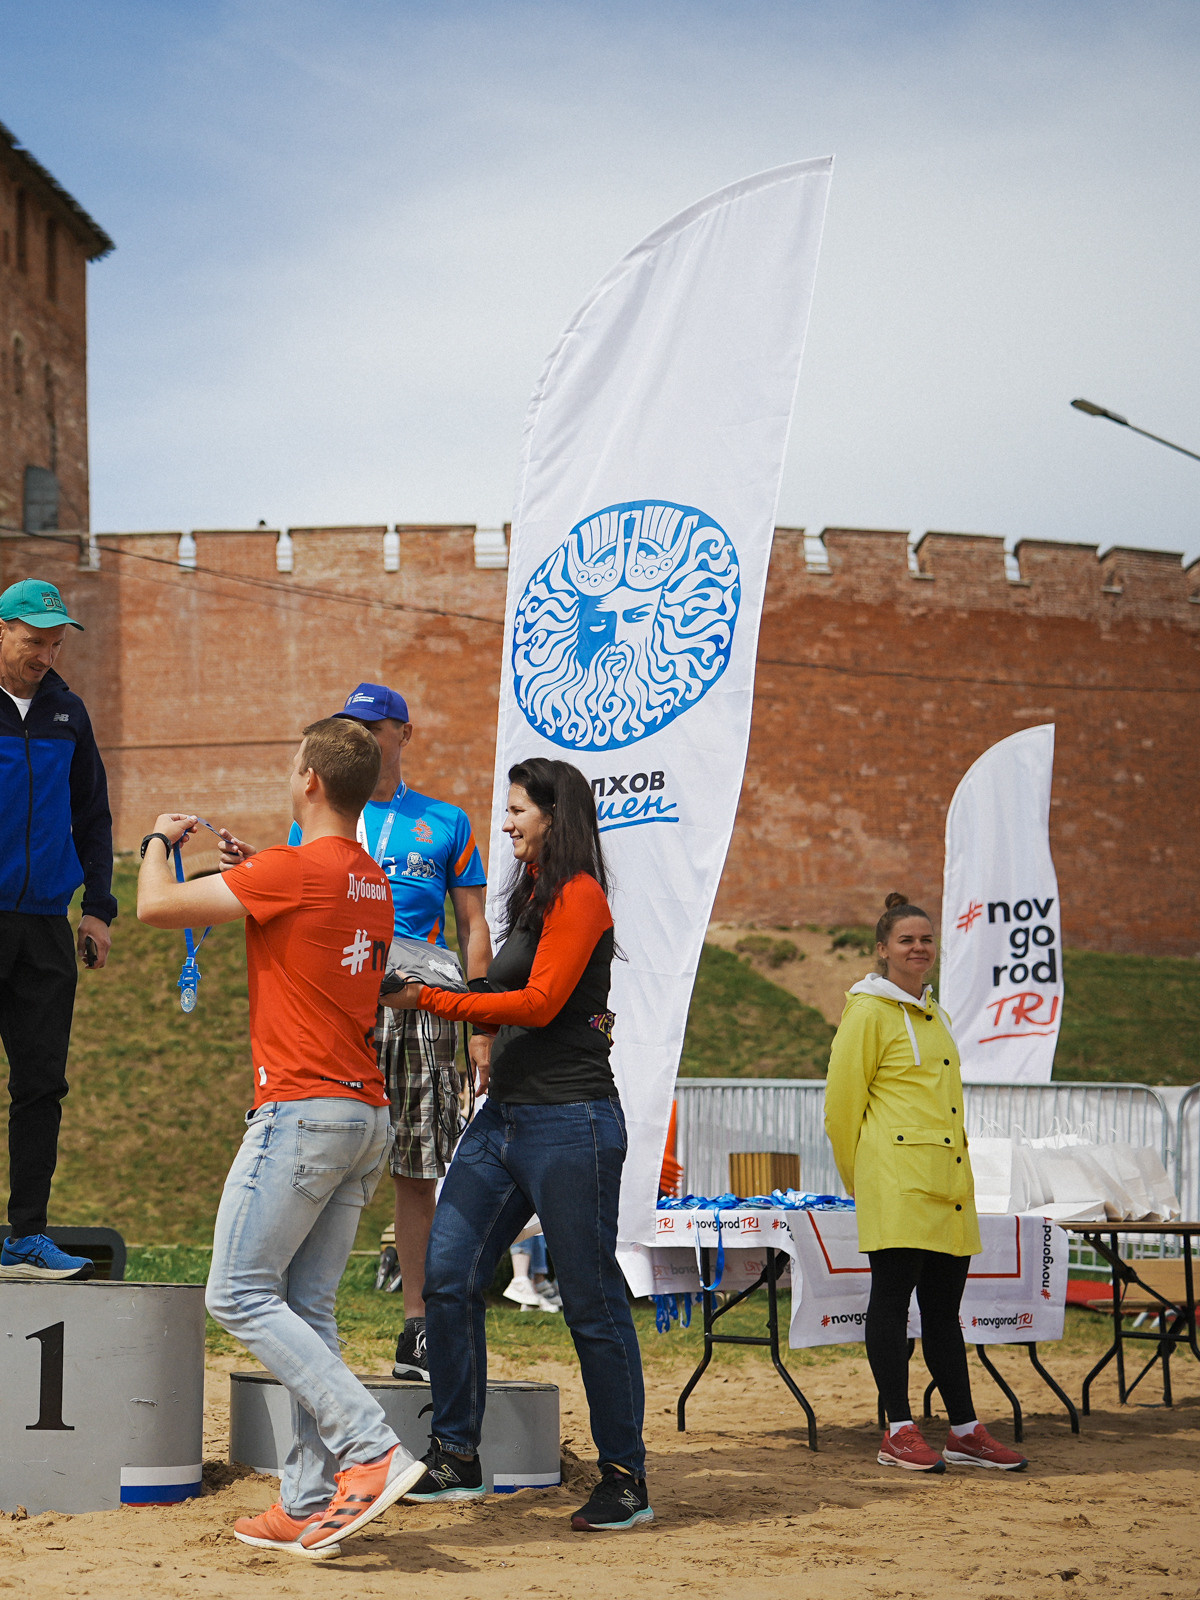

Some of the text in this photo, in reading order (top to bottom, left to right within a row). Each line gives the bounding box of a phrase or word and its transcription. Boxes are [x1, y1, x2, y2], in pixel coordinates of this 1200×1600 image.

[590, 770, 665, 797] ЛХОВ
[346, 872, 388, 902] Дубовой
[956, 898, 1055, 933] #nov
[1009, 924, 1056, 959] go
[992, 948, 1057, 987] rod
[986, 992, 1060, 1027] TRI
[25, 1321, 75, 1430] 1
